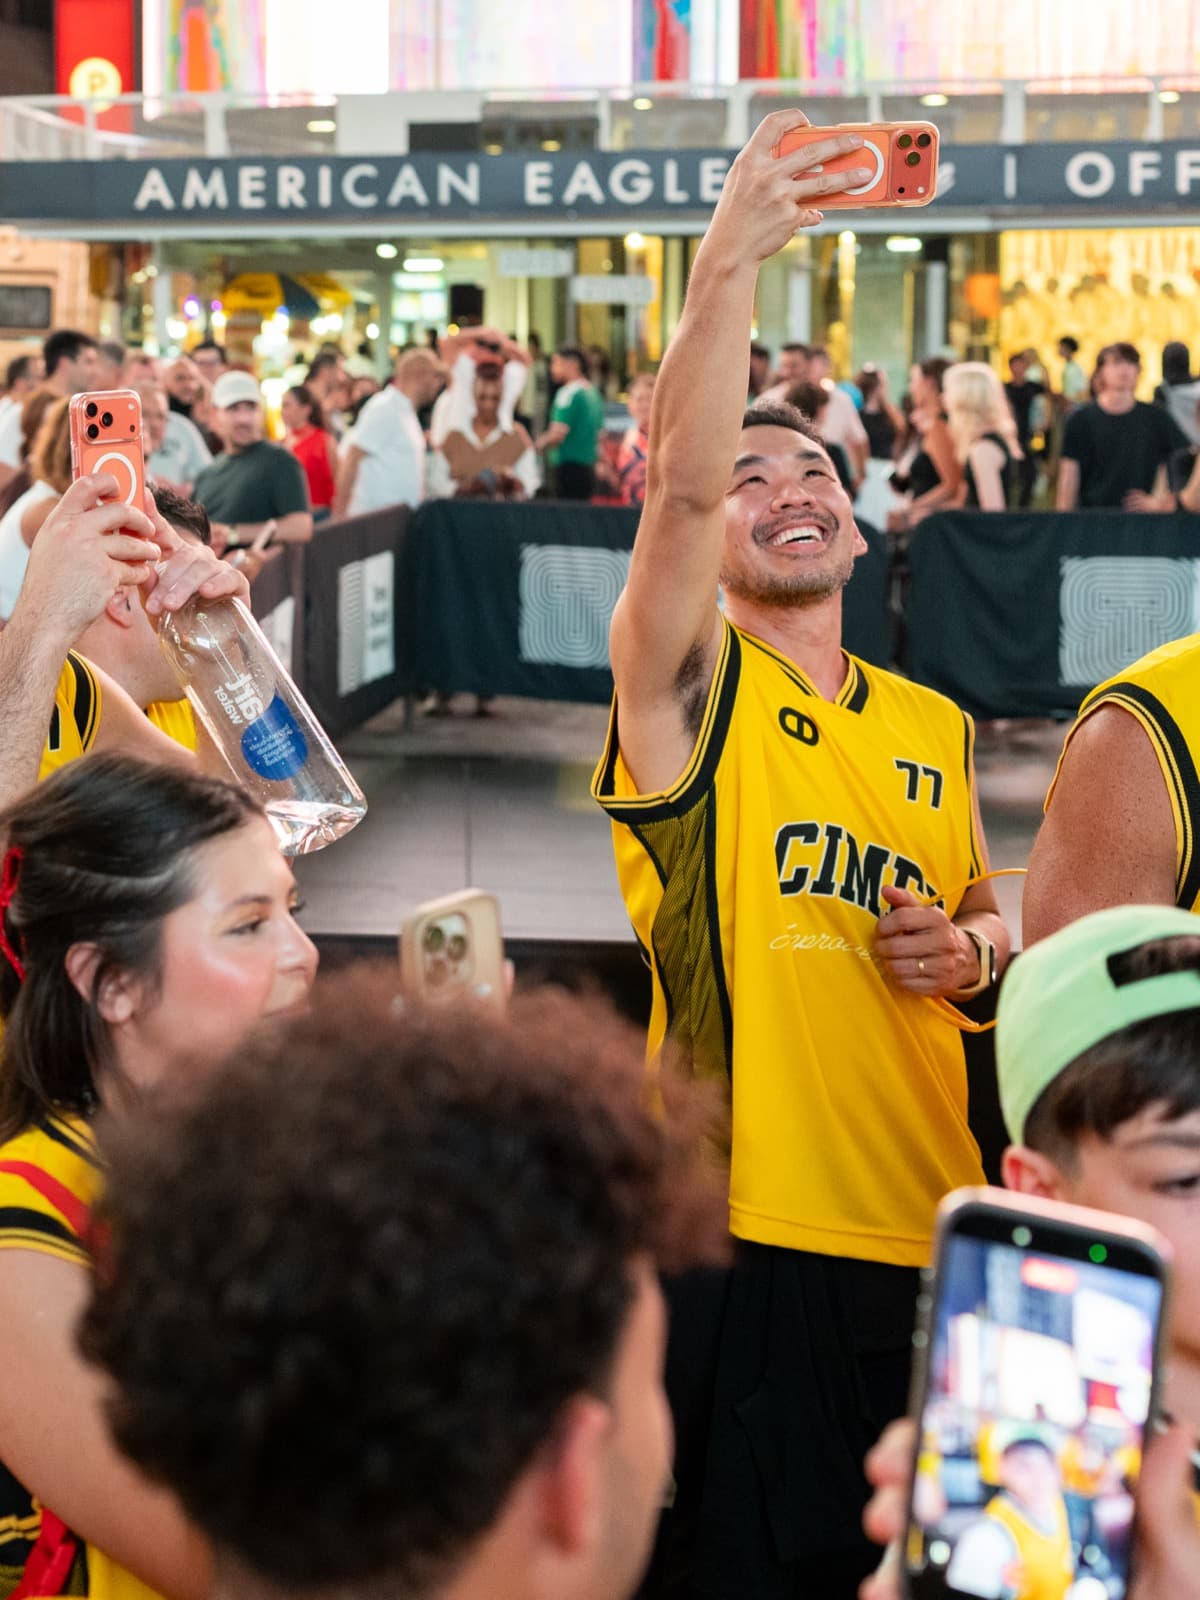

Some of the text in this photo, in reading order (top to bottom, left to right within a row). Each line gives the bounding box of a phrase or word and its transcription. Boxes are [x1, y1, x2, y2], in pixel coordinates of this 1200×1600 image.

[133, 150, 1200, 211] AMERICAN EAGLE OFF
[893, 756, 945, 810] 77
